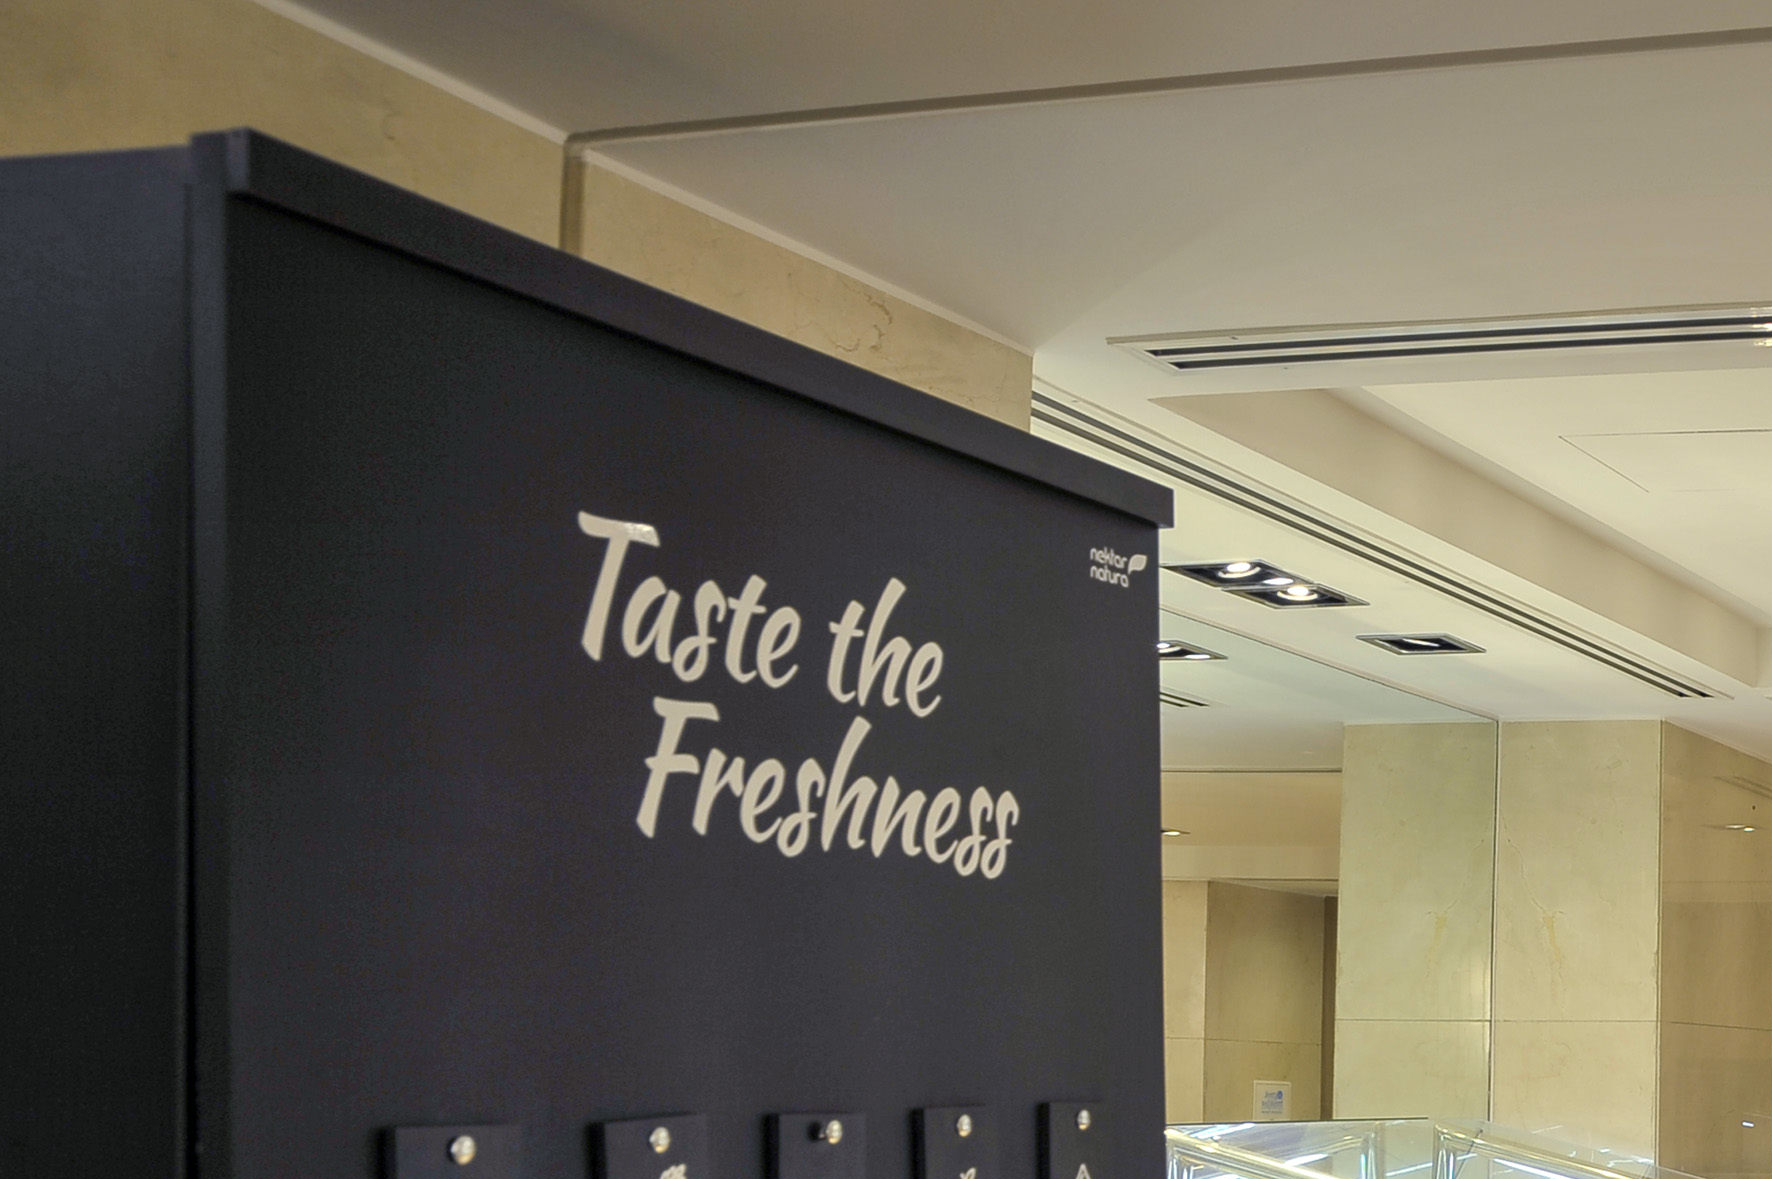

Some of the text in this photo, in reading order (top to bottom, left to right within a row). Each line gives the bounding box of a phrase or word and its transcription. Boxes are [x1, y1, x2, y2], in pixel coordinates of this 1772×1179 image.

[1089, 546, 1128, 569] nektar
[1089, 564, 1130, 588] natura
[577, 510, 944, 718] Taste the
[635, 696, 1020, 880] Freshness
